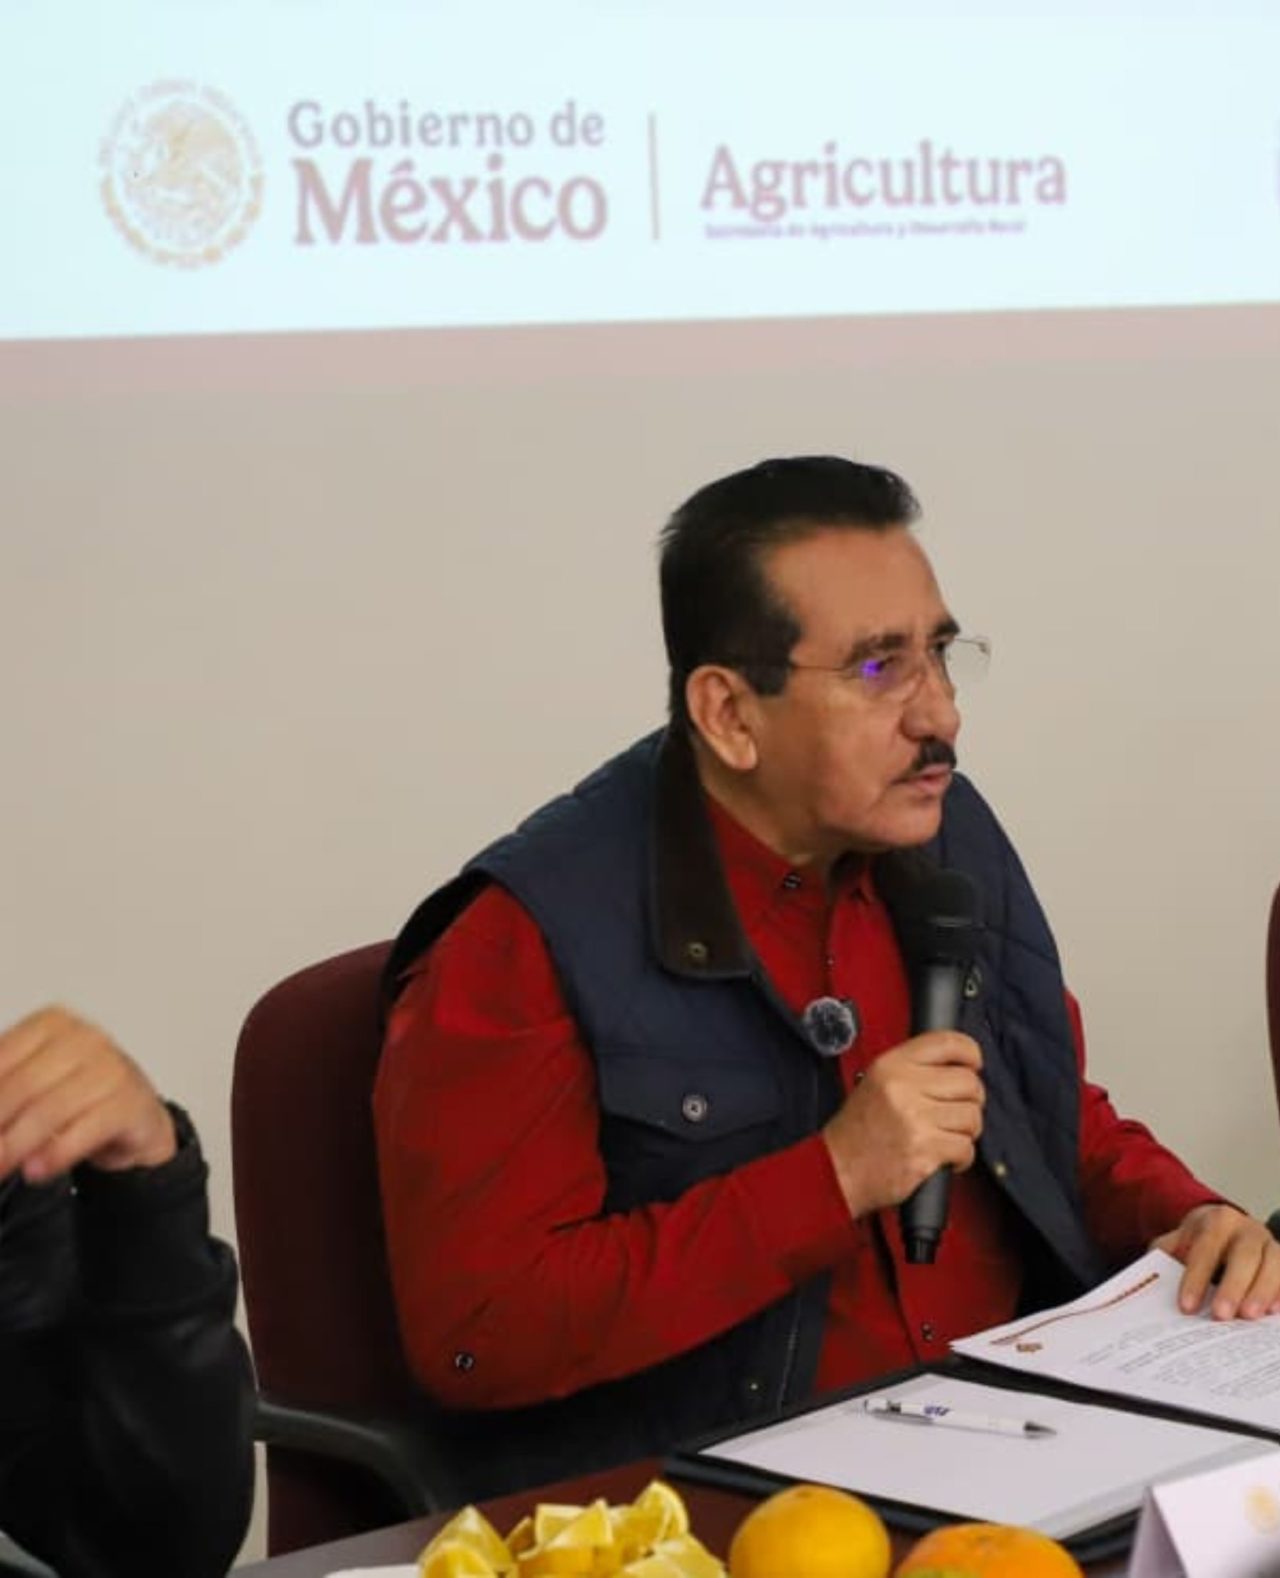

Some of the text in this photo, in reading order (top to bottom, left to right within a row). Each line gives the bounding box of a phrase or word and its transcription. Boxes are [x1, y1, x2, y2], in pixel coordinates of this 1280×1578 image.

[287, 98, 606, 149] Gobierno de
[290, 152, 608, 245] México
[701, 137, 1067, 223] Agricultura
